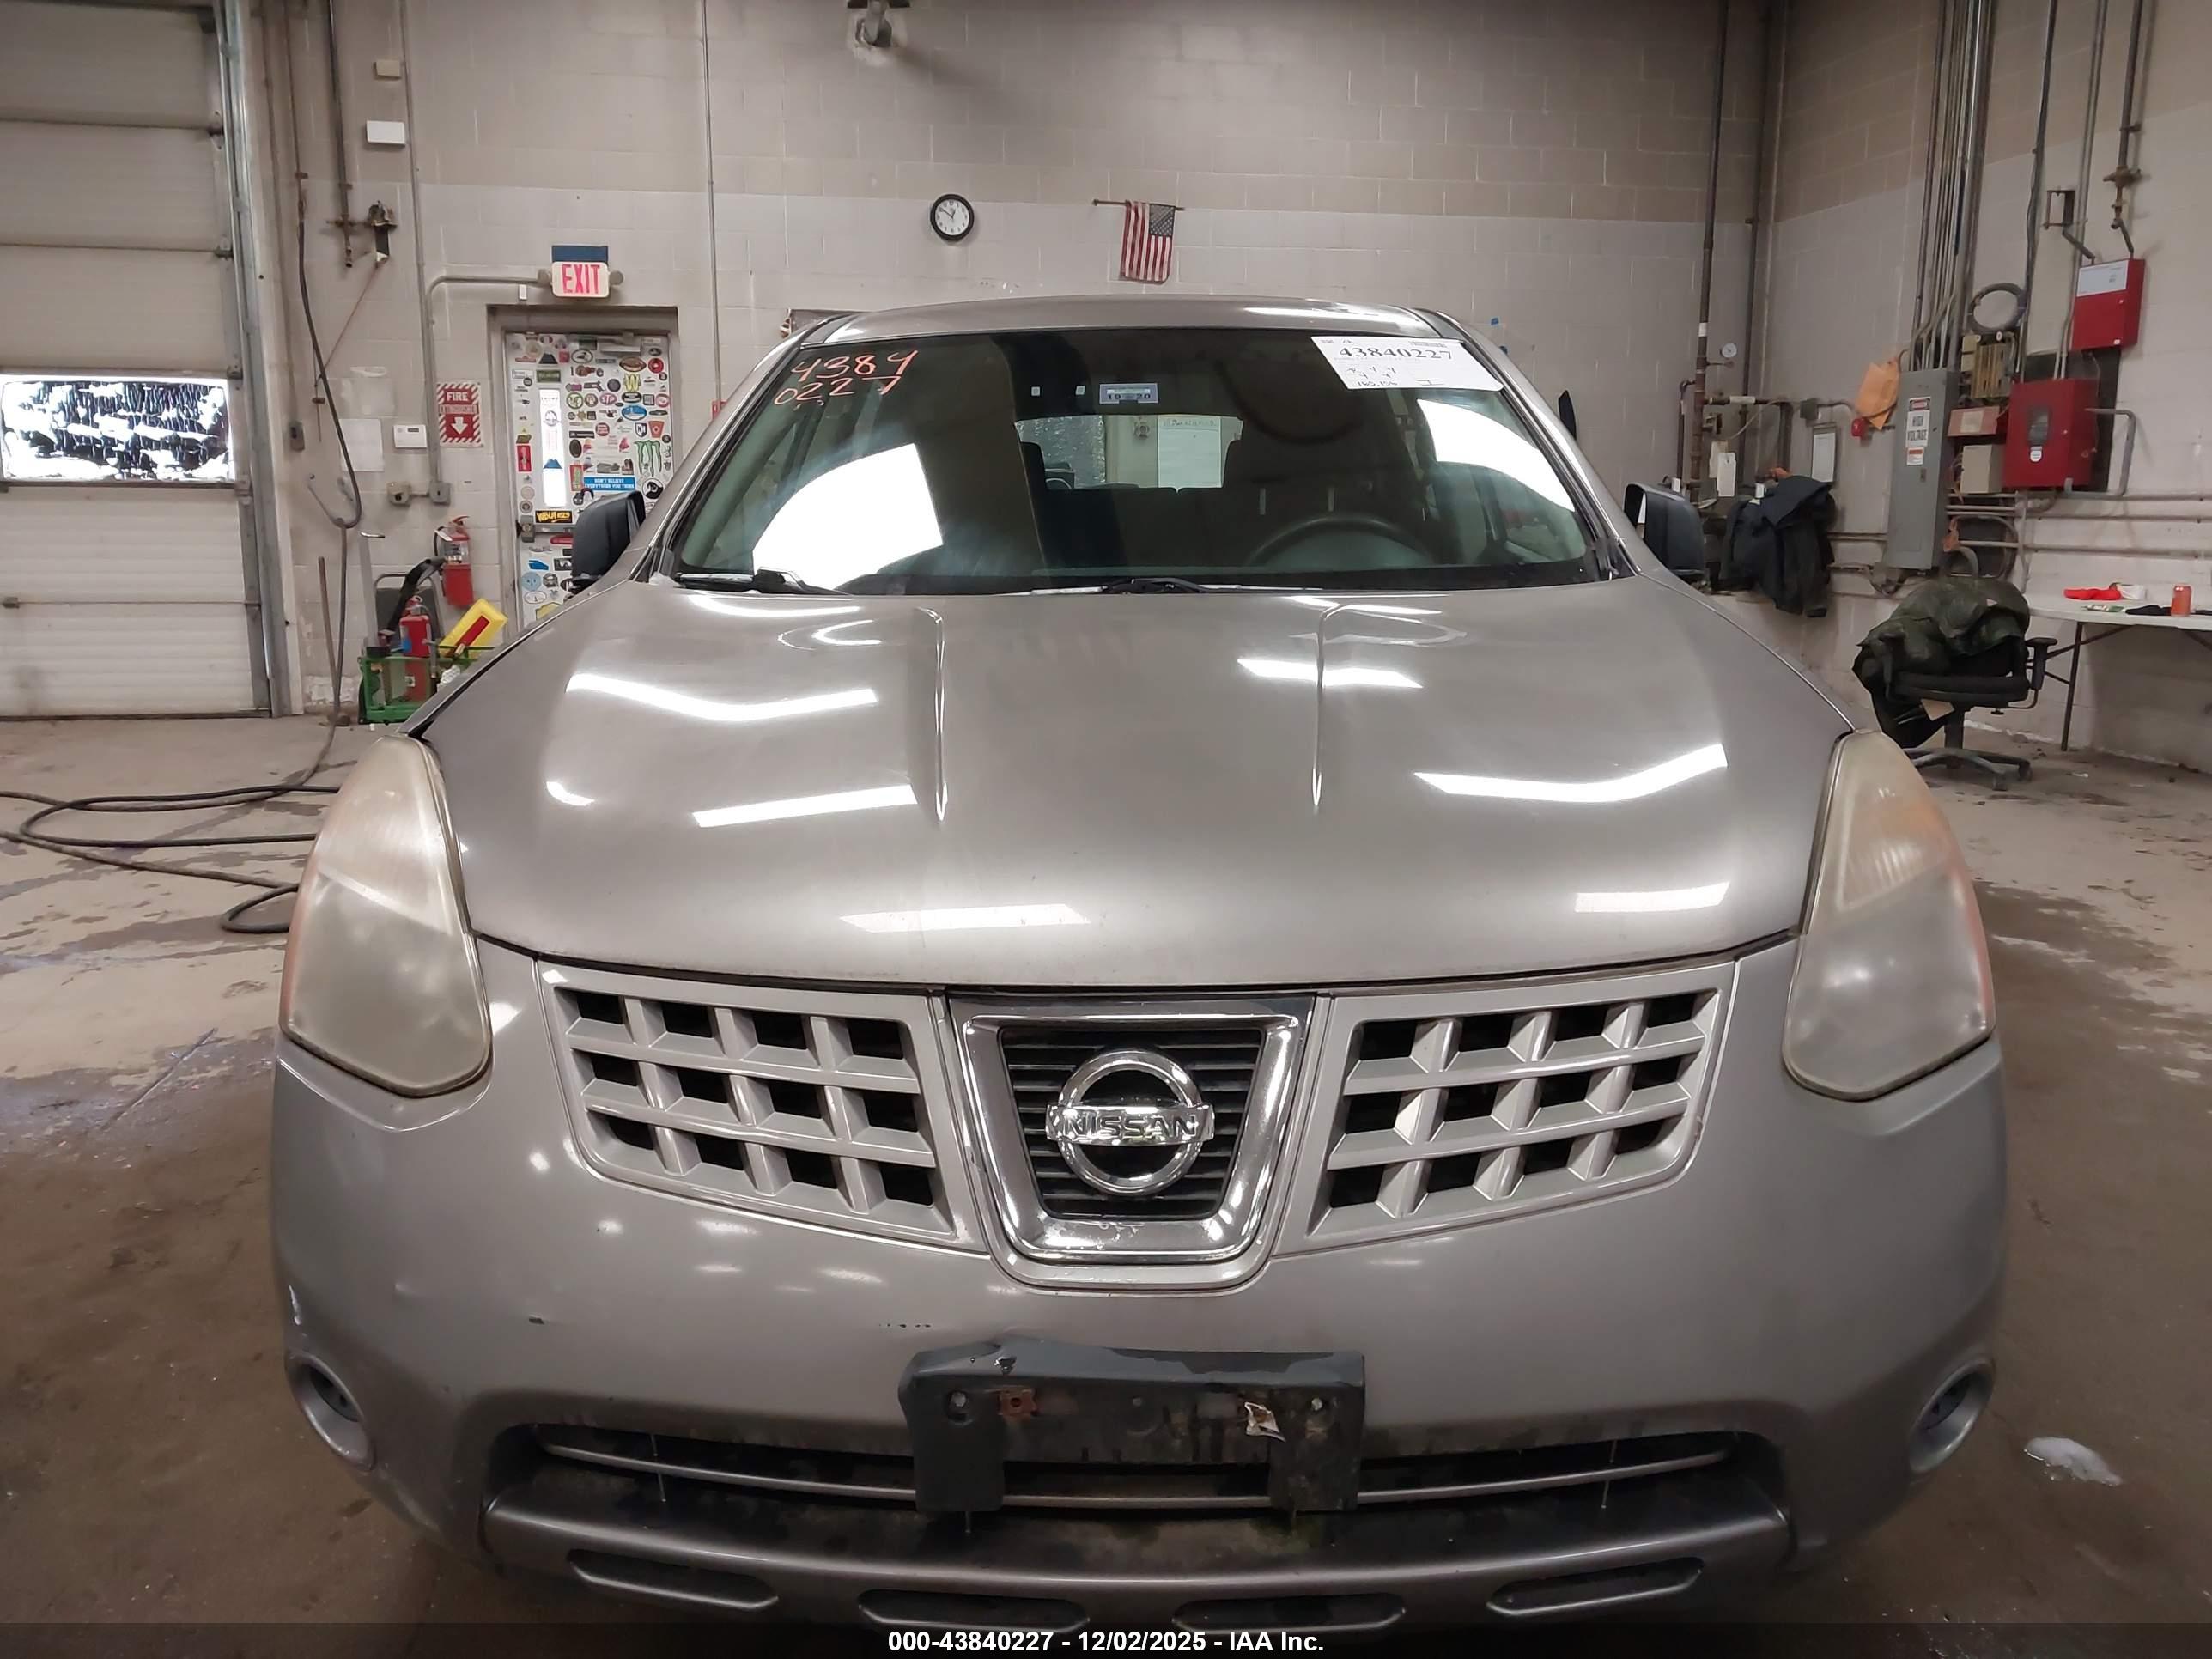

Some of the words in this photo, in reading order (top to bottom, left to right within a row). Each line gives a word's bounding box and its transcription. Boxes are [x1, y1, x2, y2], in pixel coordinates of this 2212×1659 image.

[562, 264, 600, 294] EXIT
[1339, 347, 1452, 360] 43840227
[447, 392, 469, 402] FIRE
[774, 376, 902, 405] 0227
[1063, 1111, 1196, 1141] NISSAN
